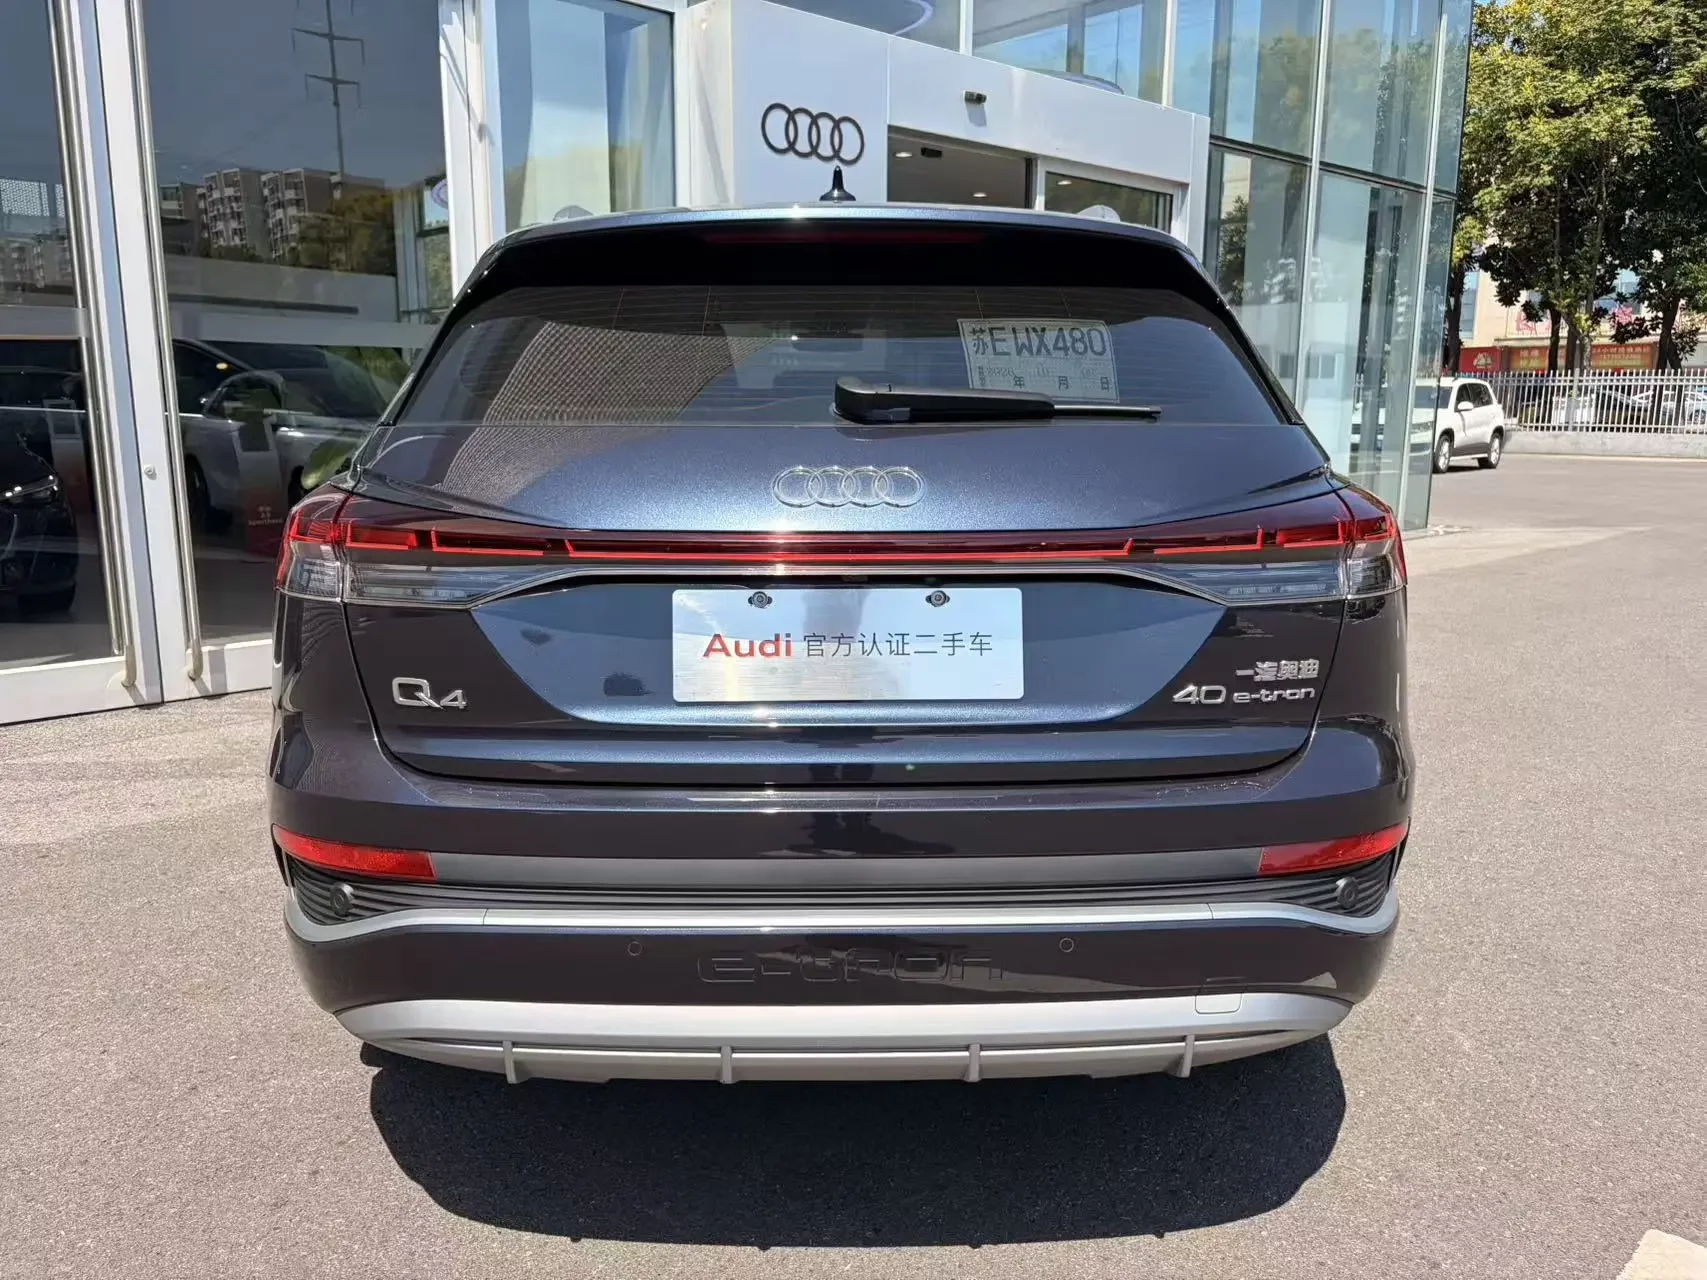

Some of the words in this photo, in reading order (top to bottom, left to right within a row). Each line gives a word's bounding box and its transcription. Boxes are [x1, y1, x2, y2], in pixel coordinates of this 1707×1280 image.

[702, 632, 793, 657] Audi
[803, 632, 993, 658] 官方认证二手车
[391, 676, 467, 710] Q4
[1172, 683, 1227, 705] 40
[1232, 687, 1316, 704] e-tron
